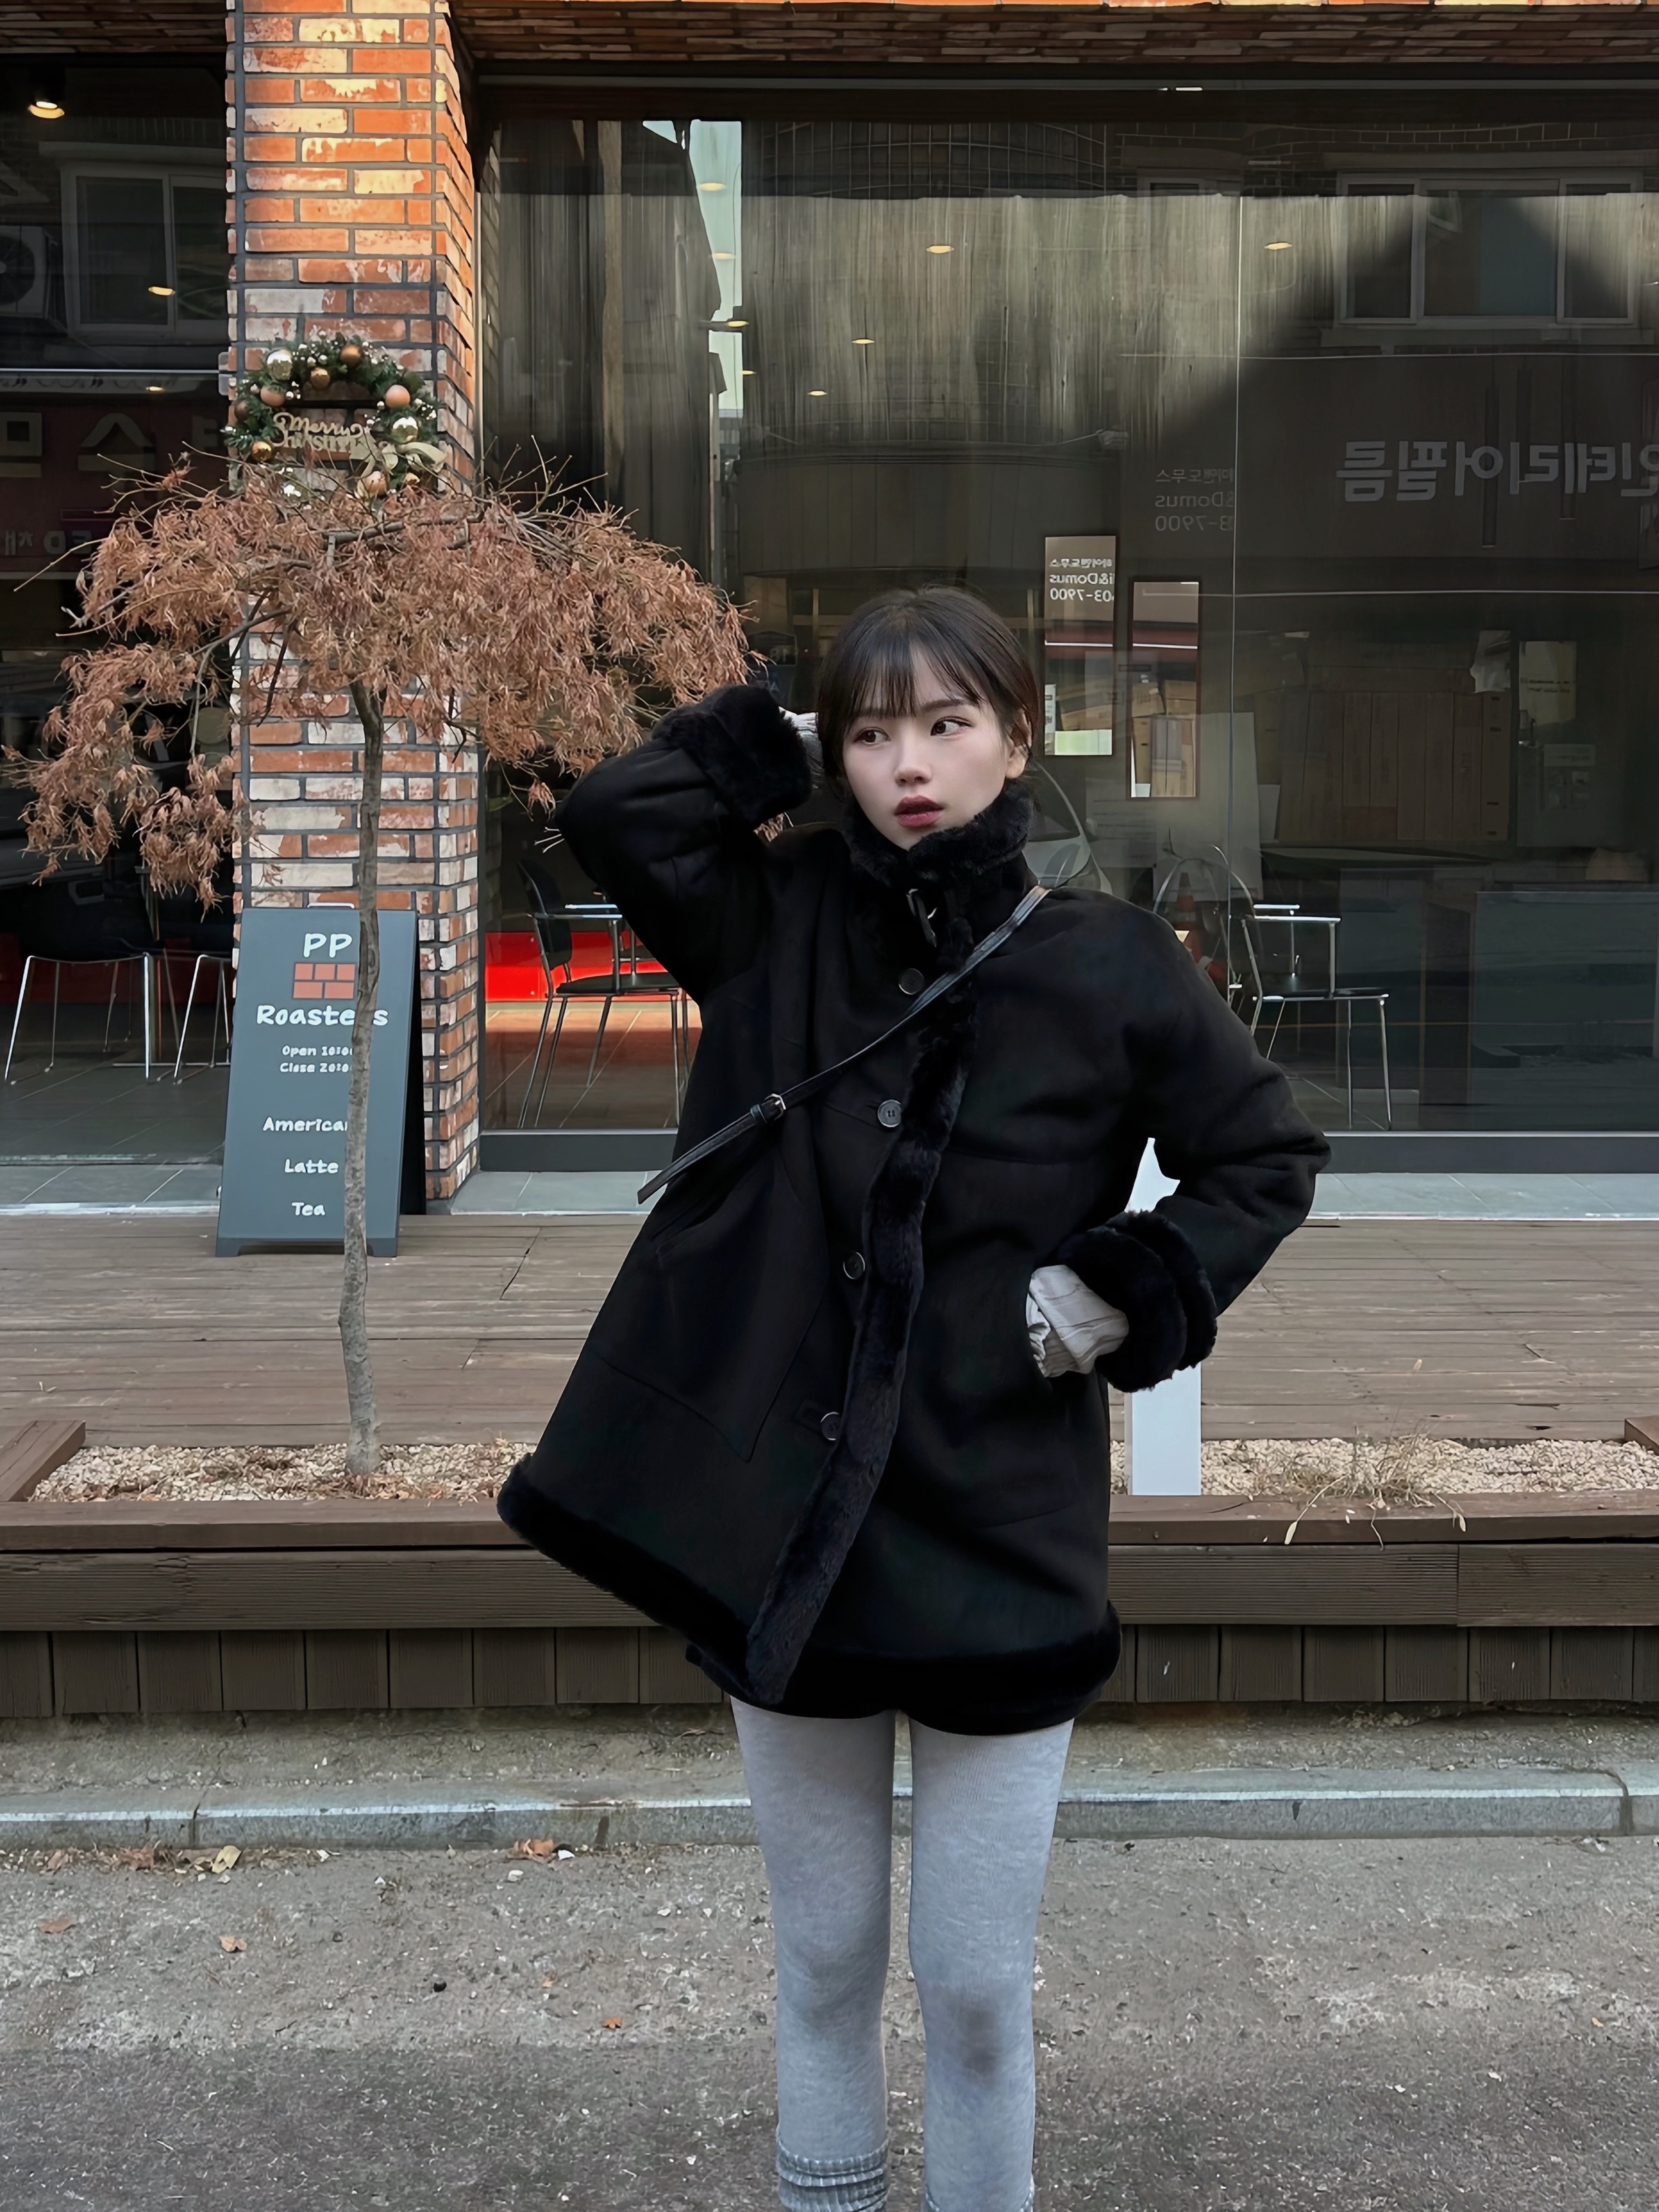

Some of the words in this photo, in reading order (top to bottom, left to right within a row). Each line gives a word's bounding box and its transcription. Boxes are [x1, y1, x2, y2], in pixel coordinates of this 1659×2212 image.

[273, 412, 364, 440] Merry
[303, 933, 352, 958] PP
[256, 1004, 389, 1027] Roastes
[282, 1045, 317, 1057] Open
[321, 1046, 353, 1056] 10:0
[280, 1062, 316, 1073] Close
[320, 1062, 351, 1073] 20:0
[284, 1159, 339, 1174] Latte
[292, 1202, 326, 1217] Tea
